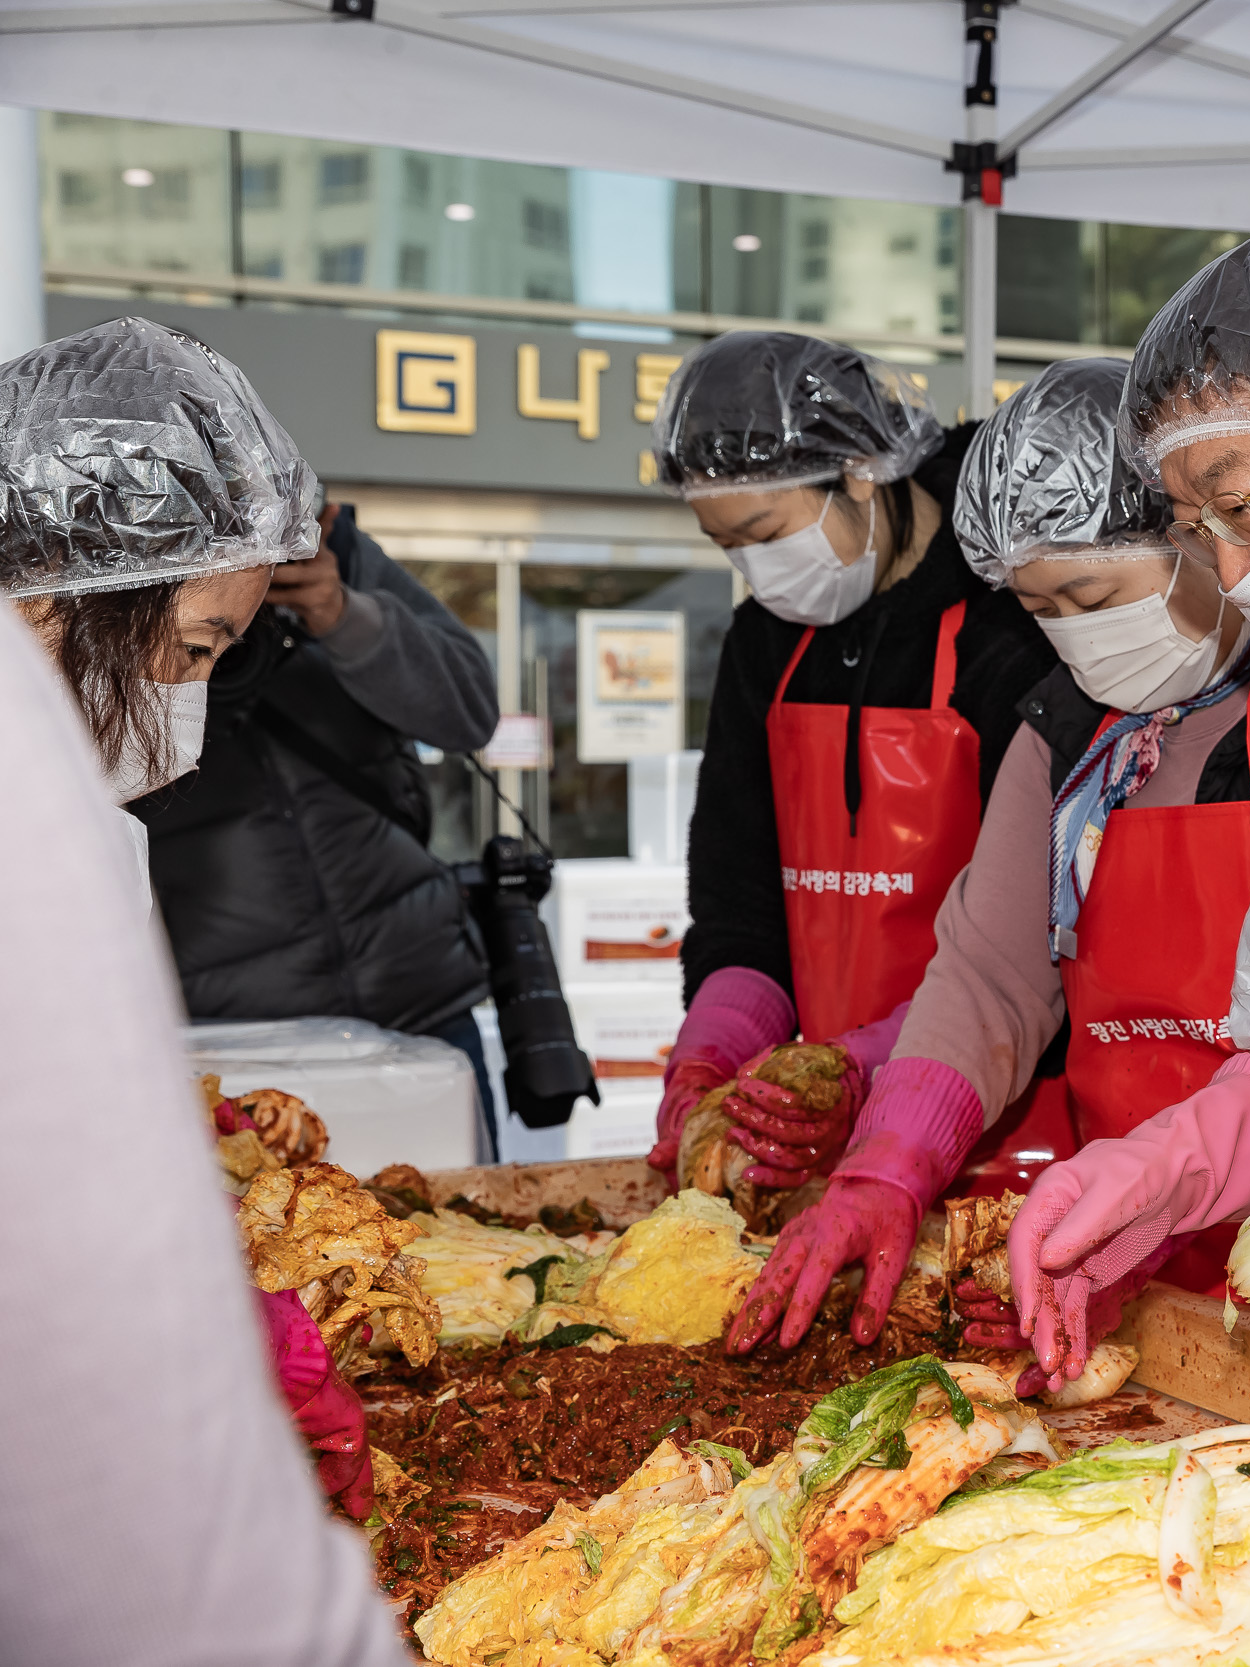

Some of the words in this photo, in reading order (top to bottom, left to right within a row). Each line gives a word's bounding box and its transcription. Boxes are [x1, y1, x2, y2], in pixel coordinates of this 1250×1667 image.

[799, 869, 841, 893] 사랑의
[1086, 1020, 1131, 1043] 광진
[1129, 1018, 1185, 1040] 사랑의
